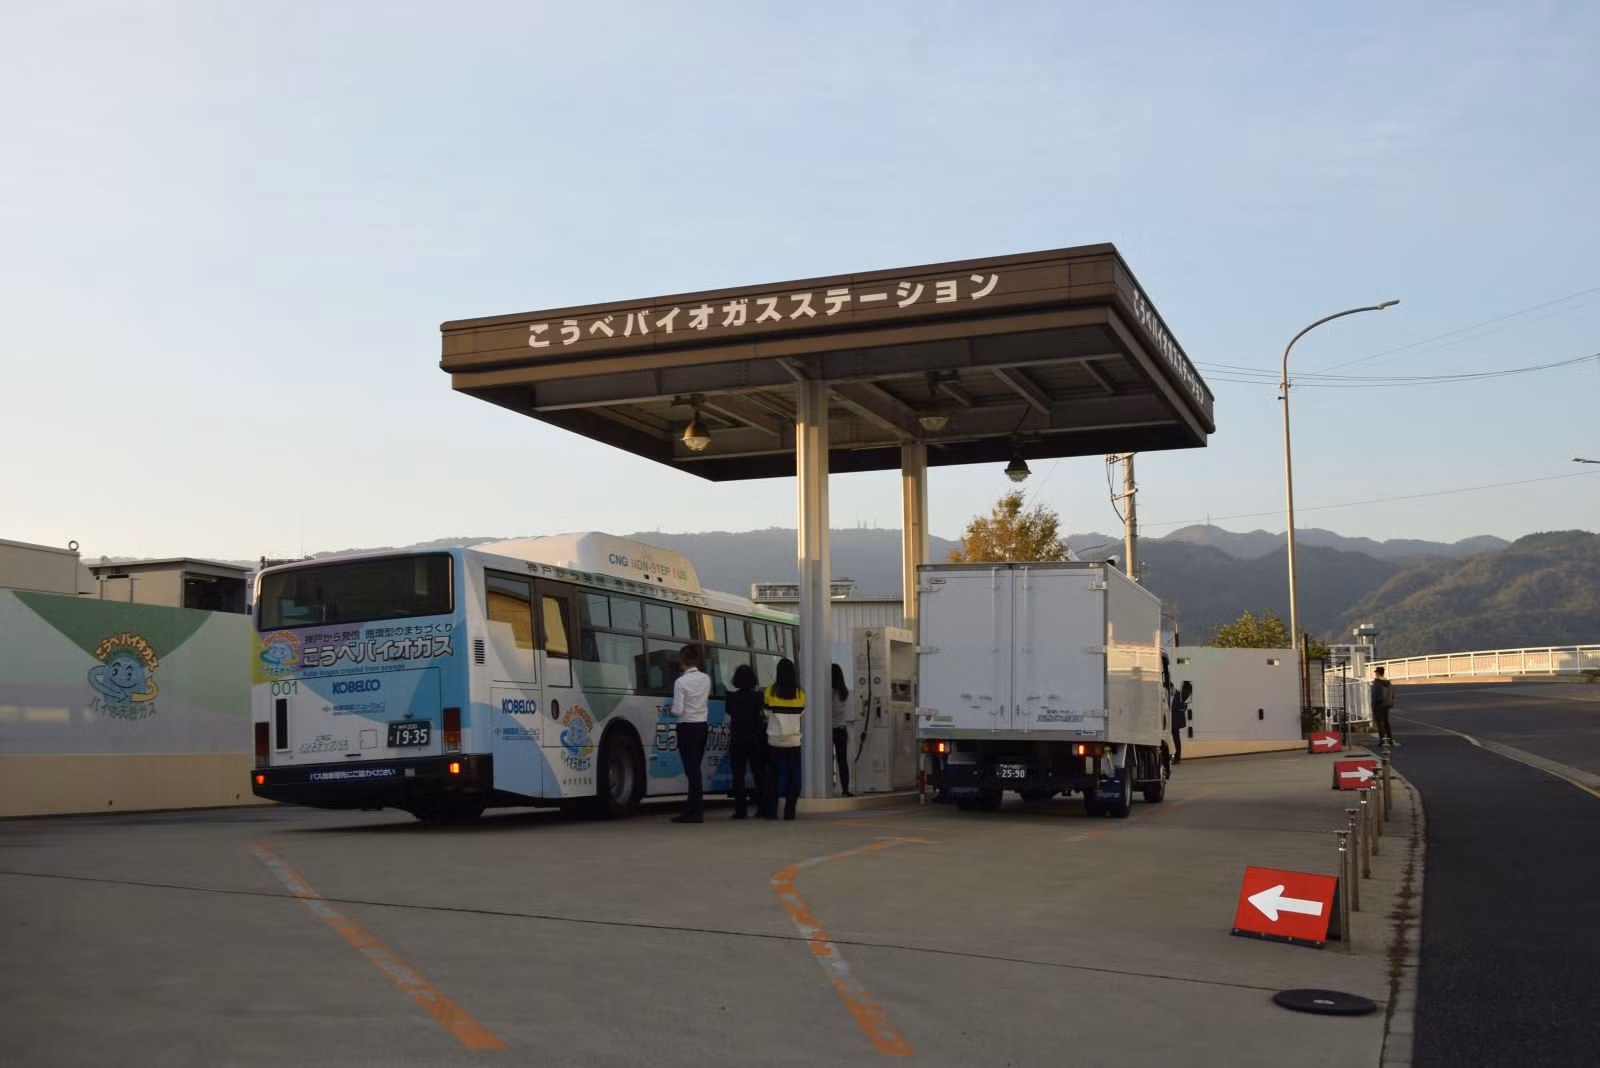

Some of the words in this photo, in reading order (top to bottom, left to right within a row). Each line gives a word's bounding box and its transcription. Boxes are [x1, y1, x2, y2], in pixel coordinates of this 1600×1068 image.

[528, 273, 1000, 348] こうべバイオガスステーション
[1133, 288, 1205, 406] こうべバイオガスステーション
[608, 553, 628, 567] CNG
[95, 632, 160, 672] こうべバイオガス
[303, 635, 453, 668] こうべバイオガス
[271, 681, 298, 697] 001
[332, 679, 380, 694] KOBELCO
[502, 698, 537, 715] KOBELCO
[396, 728, 429, 745] 19-35
[1001, 769, 1025, 778] 25-90
